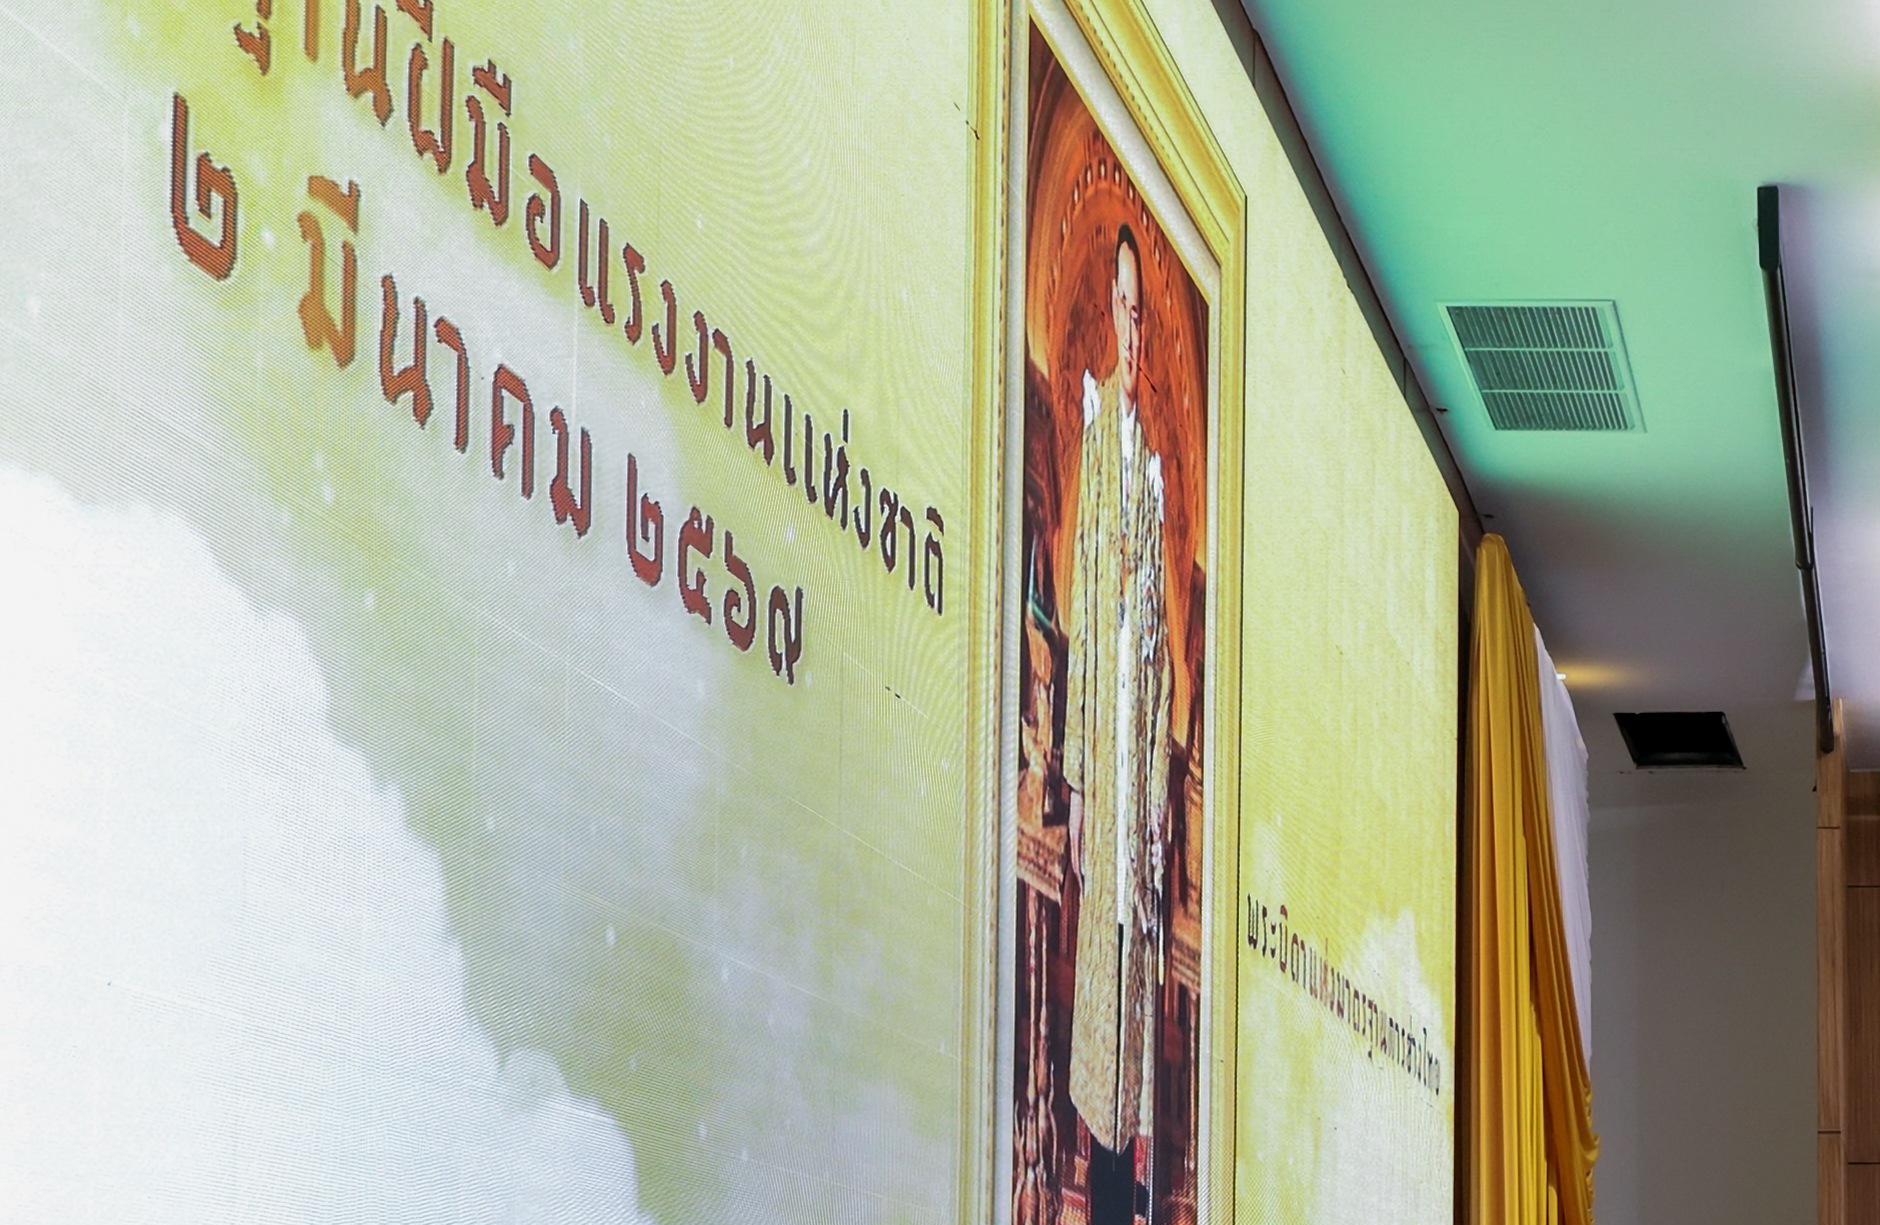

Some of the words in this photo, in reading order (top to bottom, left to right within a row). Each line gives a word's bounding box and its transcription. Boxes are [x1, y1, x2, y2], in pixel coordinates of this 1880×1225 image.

[171, 92, 238, 281] ๒
[297, 174, 593, 539] มีนาคม
[626, 452, 804, 686] ๒๕๖๙
